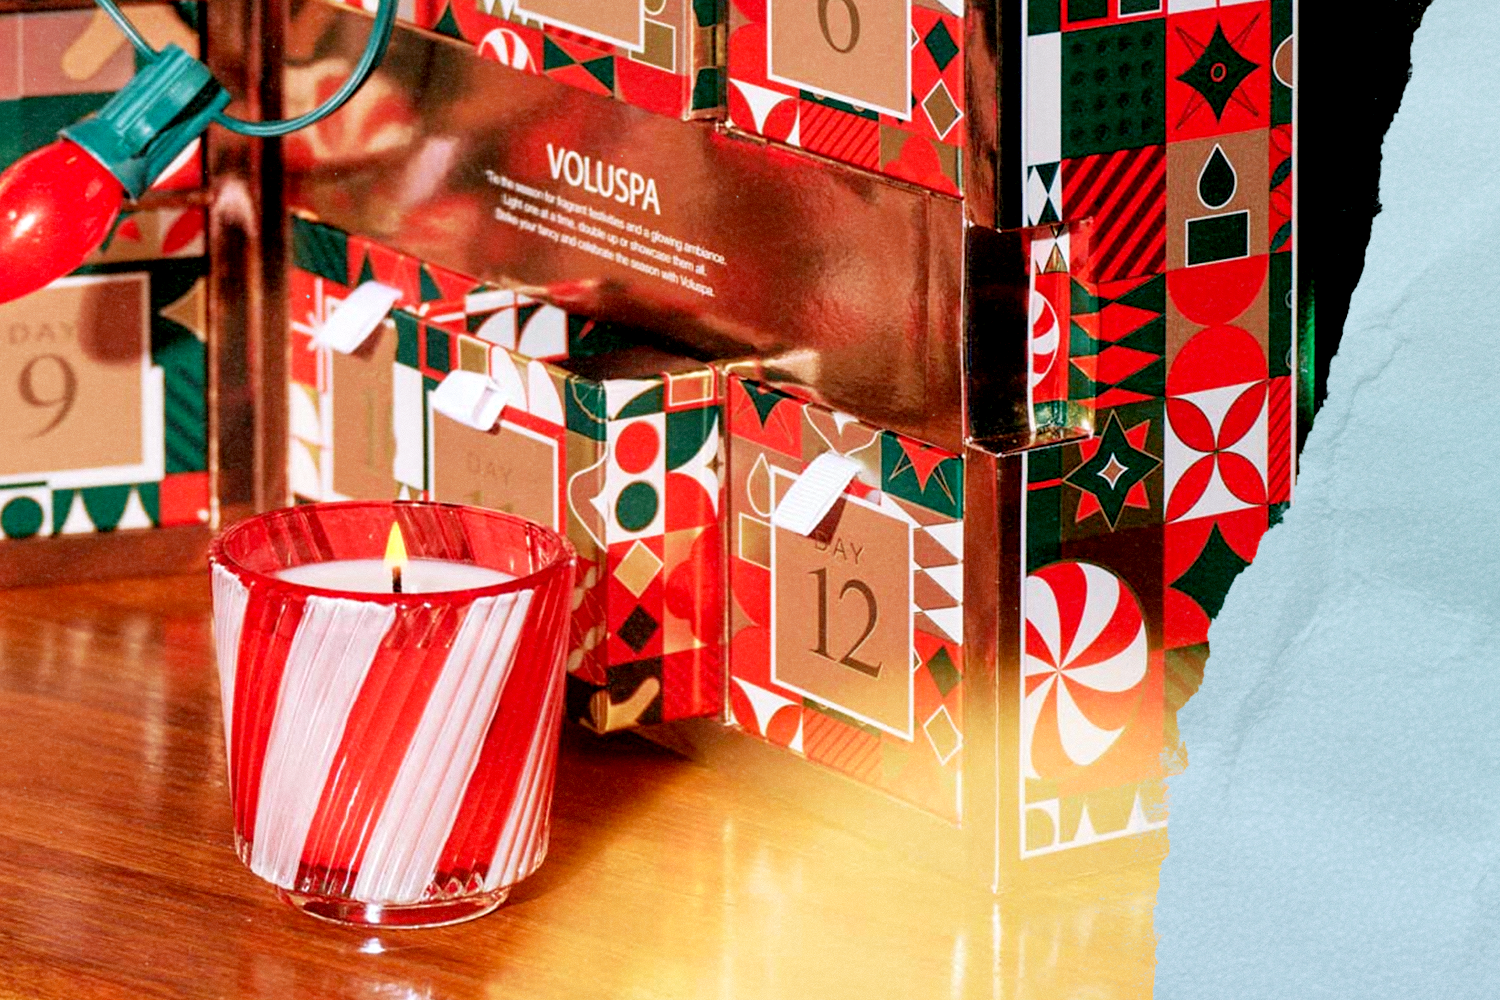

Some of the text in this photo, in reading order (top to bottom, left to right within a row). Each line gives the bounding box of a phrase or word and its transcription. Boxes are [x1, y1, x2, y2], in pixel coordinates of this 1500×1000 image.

[547, 143, 660, 215] VOLUSPA
[524, 202, 539, 217] one
[578, 221, 606, 240] double
[606, 233, 618, 246] up
[619, 237, 628, 249] or
[629, 241, 672, 264] showcase
[672, 254, 694, 272] them
[537, 223, 560, 243] fancy
[560, 233, 576, 247] and
[578, 240, 614, 261] celebrate
[615, 252, 629, 267] the
[630, 259, 660, 278] season
[661, 270, 678, 284] with
[679, 274, 715, 297] Voluspa.
[625, 222, 642, 236] and
[650, 230, 682, 252] glowing
[8, 320, 76, 344] DAY
[18, 353, 77, 440] 9
[808, 566, 882, 678] 12
